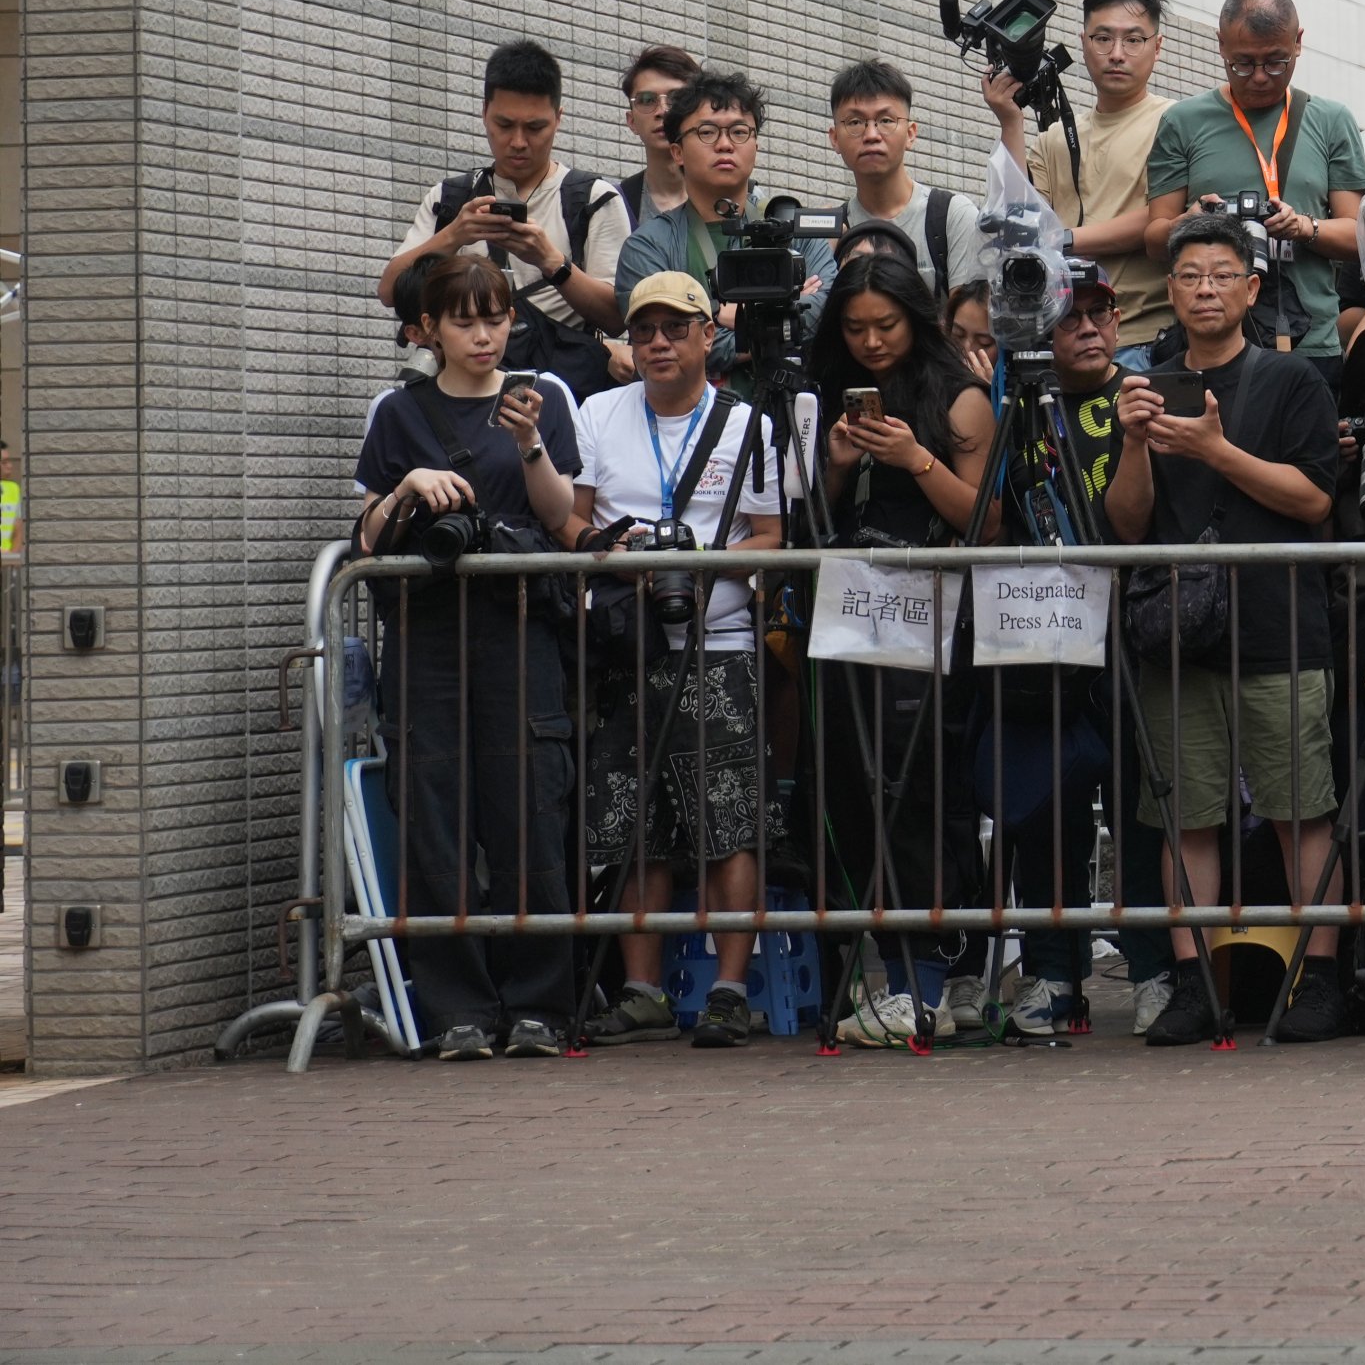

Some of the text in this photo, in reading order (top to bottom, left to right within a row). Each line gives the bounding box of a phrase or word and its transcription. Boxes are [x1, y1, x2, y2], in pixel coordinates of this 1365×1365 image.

[1067, 126, 1077, 149] SONY
[996, 581, 1086, 602] Designated
[841, 587, 933, 626] 記者區
[998, 611, 1083, 630] Press Area
